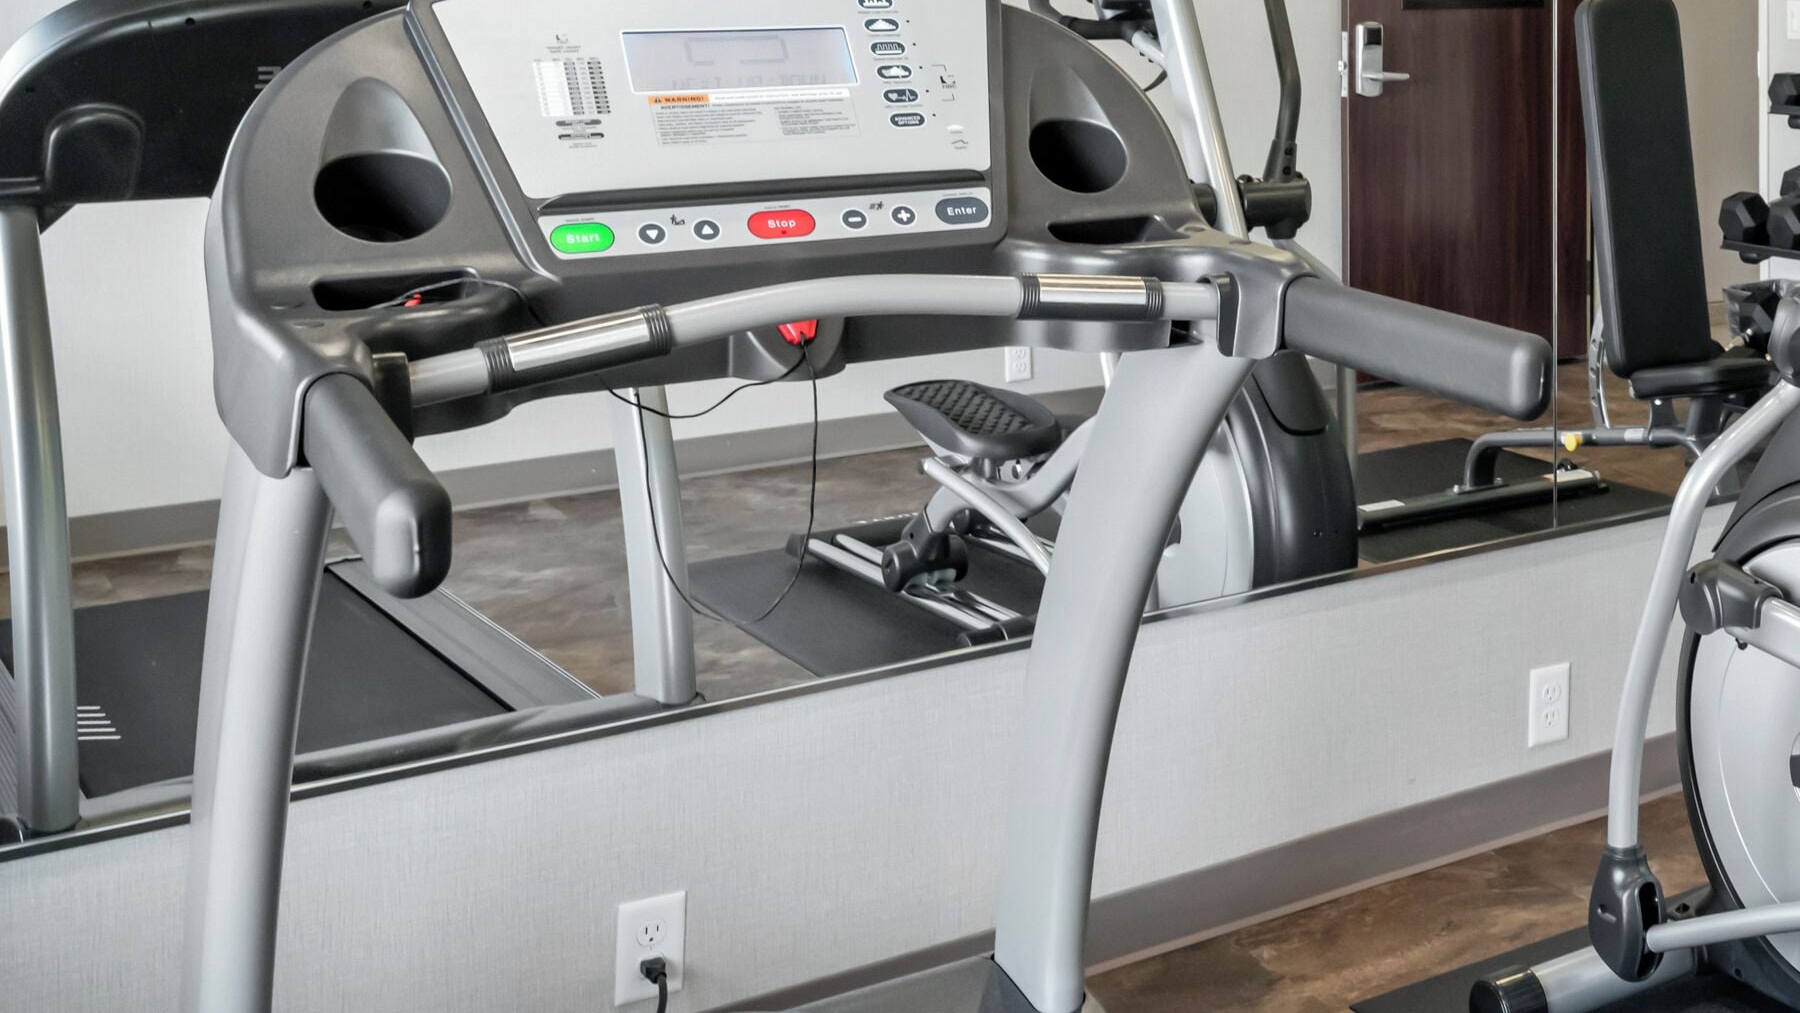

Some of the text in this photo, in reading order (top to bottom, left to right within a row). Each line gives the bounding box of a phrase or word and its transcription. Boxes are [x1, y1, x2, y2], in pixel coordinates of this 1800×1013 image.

[947, 206, 977, 216] Enter
[767, 219, 797, 229] Stop
[565, 232, 600, 244] Start
